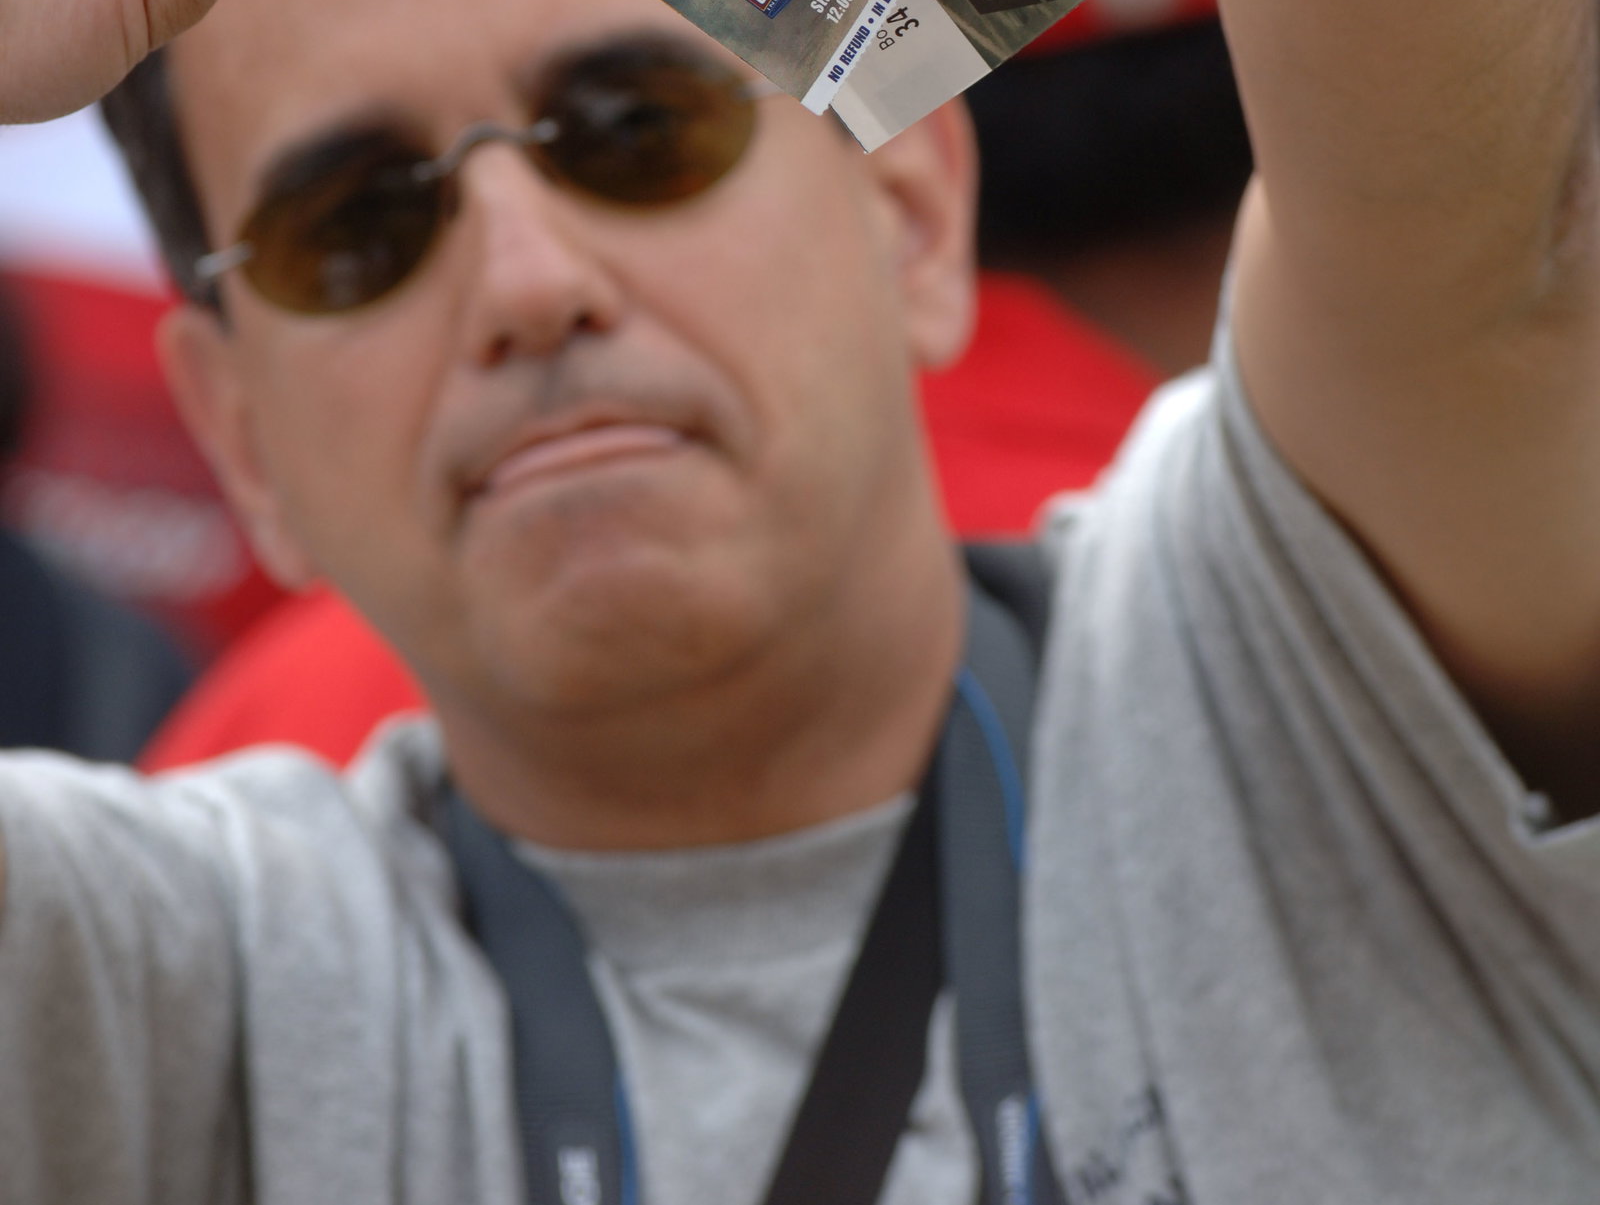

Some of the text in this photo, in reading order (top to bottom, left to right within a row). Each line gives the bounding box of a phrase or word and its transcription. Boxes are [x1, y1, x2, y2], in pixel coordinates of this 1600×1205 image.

[886, 6, 920, 37] 34
[827, 64, 845, 83] NO
[839, 25, 871, 65] REFUND
[871, 2, 886, 17] IN
[876, 25, 896, 51] Bo
